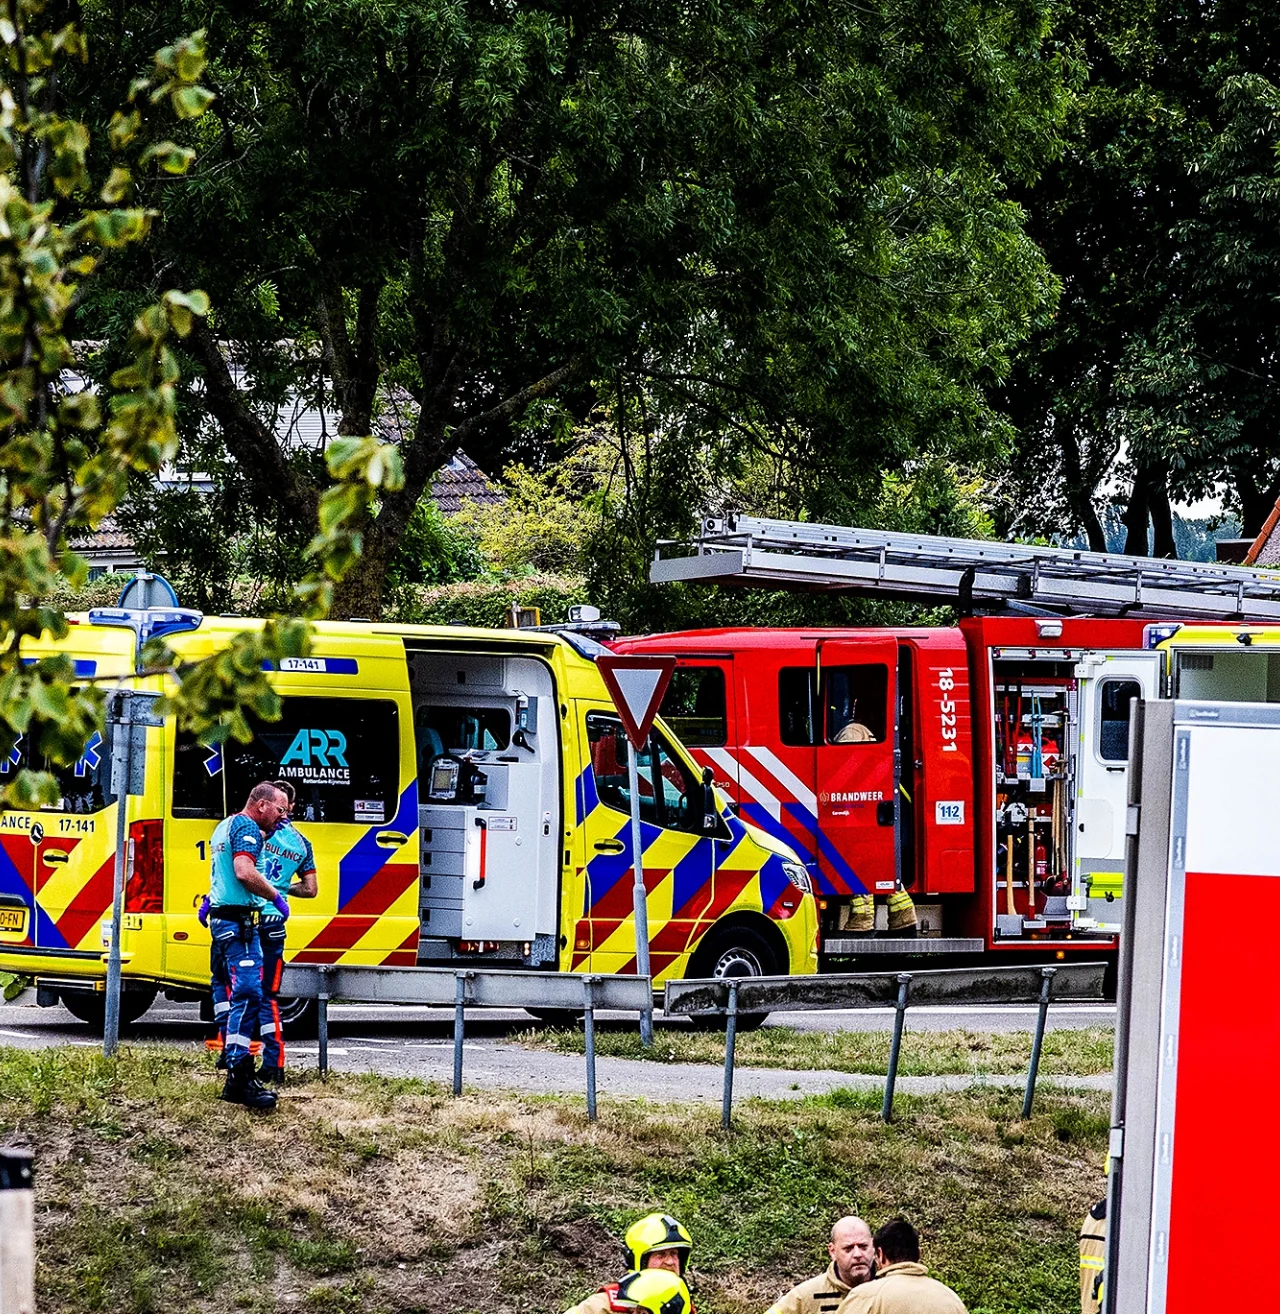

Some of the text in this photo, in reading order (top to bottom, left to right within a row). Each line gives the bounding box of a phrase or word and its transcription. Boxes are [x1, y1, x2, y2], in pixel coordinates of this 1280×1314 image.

[287, 659, 320, 670] 17-141
[938, 667, 958, 752] 18-5231
[279, 729, 350, 767] ARR
[278, 767, 350, 779] AMBULANCE
[830, 791, 883, 802] BRANDWEER
[59, 819, 96, 833] 17-141
